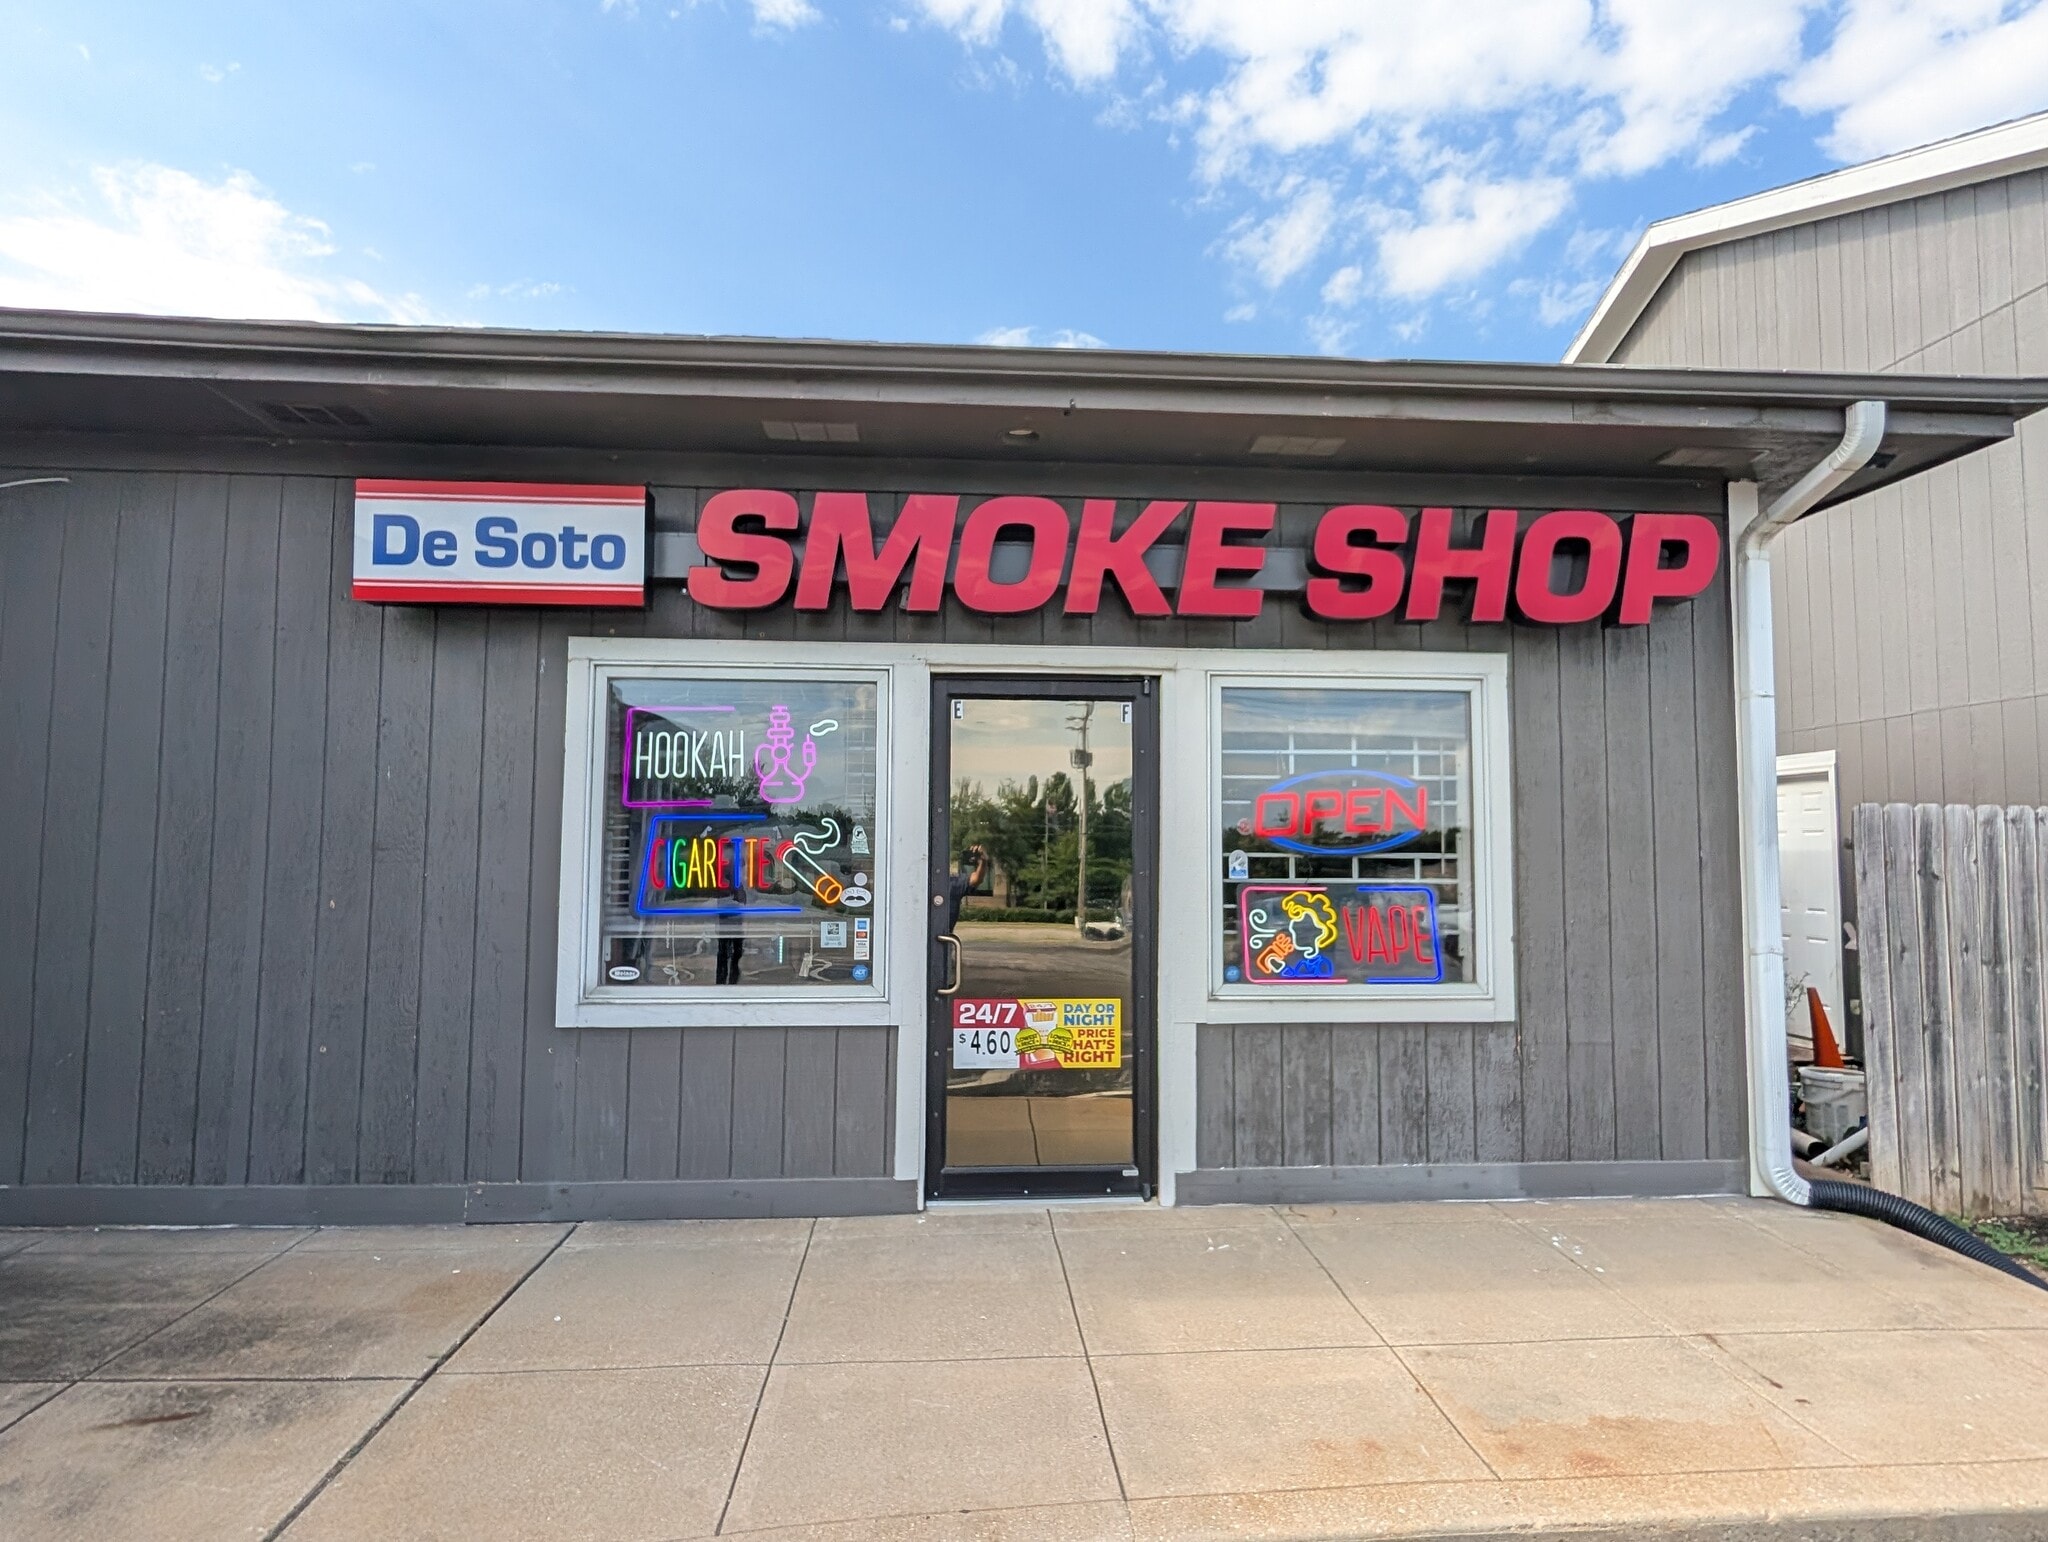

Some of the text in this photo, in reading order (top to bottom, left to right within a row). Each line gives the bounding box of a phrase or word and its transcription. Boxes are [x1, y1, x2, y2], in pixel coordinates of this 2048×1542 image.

[371, 513, 627, 570] De Soto
[687, 488, 1721, 625] SMOKE SHOP
[954, 701, 962, 719] E
[1122, 704, 1130, 722] F
[635, 730, 745, 779] HOOKAH
[1254, 785, 1429, 838] OPEN
[650, 837, 773, 889] CIGARETTE
[1342, 905, 1434, 965] VAPE
[959, 1003, 1018, 1024] 24/7
[1064, 1003, 1115, 1013] DAY OR
[1064, 1014, 1115, 1026] NIGHT
[1077, 1029, 1116, 1038] PRICE
[1072, 1039, 1115, 1050] HAT'S
[1064, 1050, 1115, 1063] RIGHT
